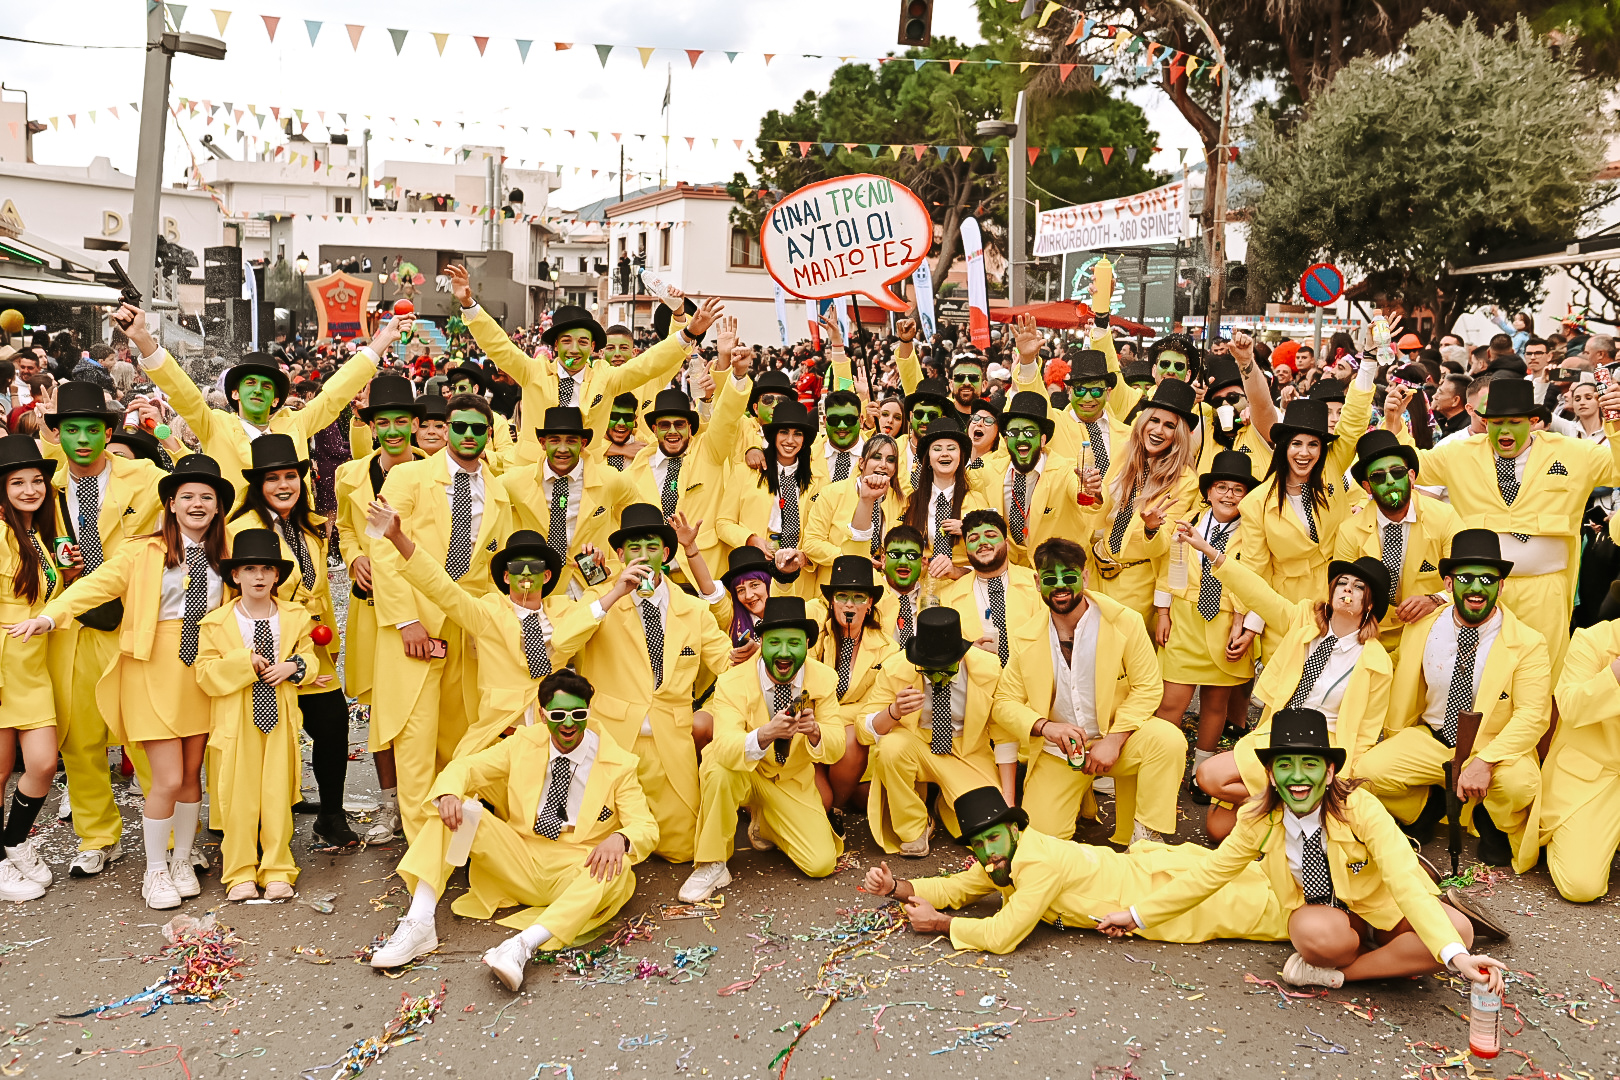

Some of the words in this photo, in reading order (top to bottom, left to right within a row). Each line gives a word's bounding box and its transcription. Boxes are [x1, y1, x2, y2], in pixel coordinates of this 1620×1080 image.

[772, 197, 822, 234] ΕΙΝΑΙ
[825, 178, 894, 216] ΤΡΕΛΟΙ
[1040, 202, 1104, 234] PHOTO
[1114, 184, 1183, 219] POINT
[787, 217, 860, 264] ΑΥΤΟΙ
[866, 210, 894, 242] ΟΙ
[1036, 223, 1110, 254] MIRRORBOOTH
[1119, 219, 1137, 242] 360
[1140, 211, 1182, 239] SPINER
